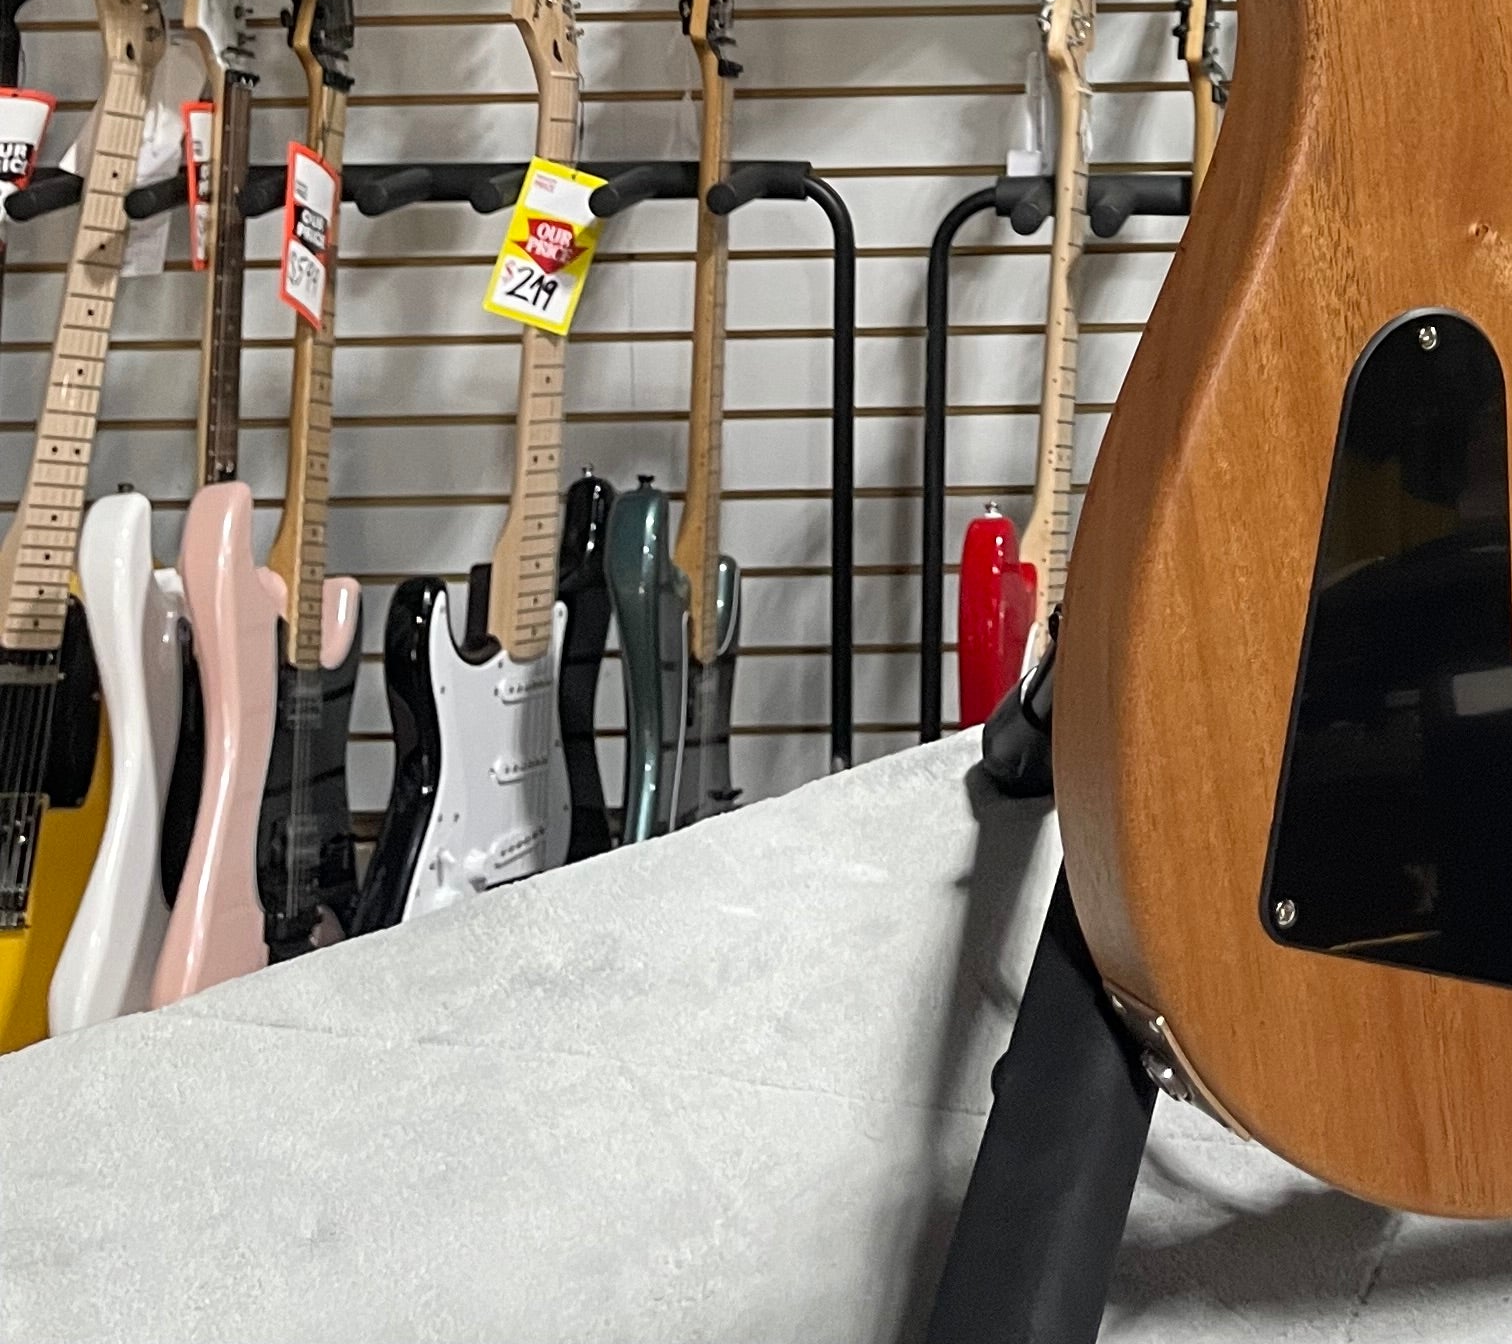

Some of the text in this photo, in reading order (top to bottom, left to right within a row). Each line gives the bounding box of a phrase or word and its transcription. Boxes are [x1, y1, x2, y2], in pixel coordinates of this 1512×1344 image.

[0, 142, 27, 161] UR
[535, 221, 574, 248] OUR
[524, 236, 577, 263] PRICE
